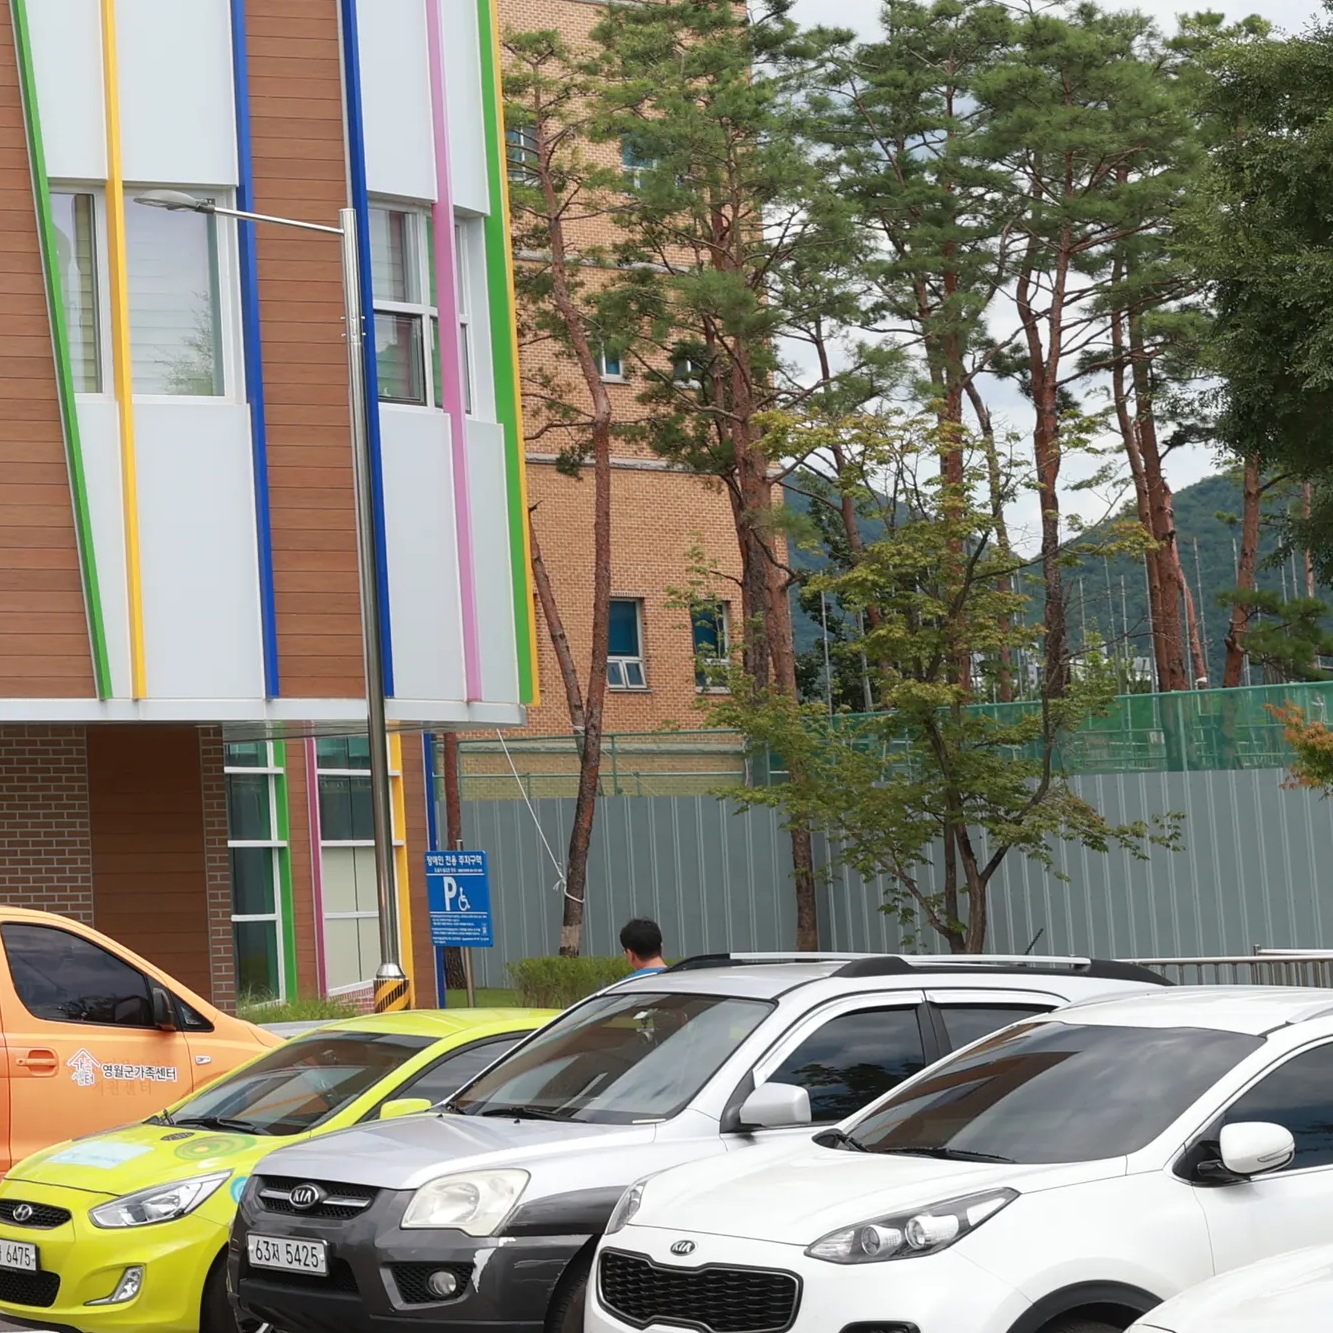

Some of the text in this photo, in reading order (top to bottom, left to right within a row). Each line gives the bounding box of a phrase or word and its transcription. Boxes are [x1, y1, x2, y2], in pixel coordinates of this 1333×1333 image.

[443, 876, 457, 911] P
[102, 1064, 176, 1081] 영월군가족센터
[293, 1189, 312, 1203] KIA
[6, 1244, 31, 1267] 6475
[255, 1239, 319, 1268] 63저 5425
[672, 1241, 692, 1253] KIA
